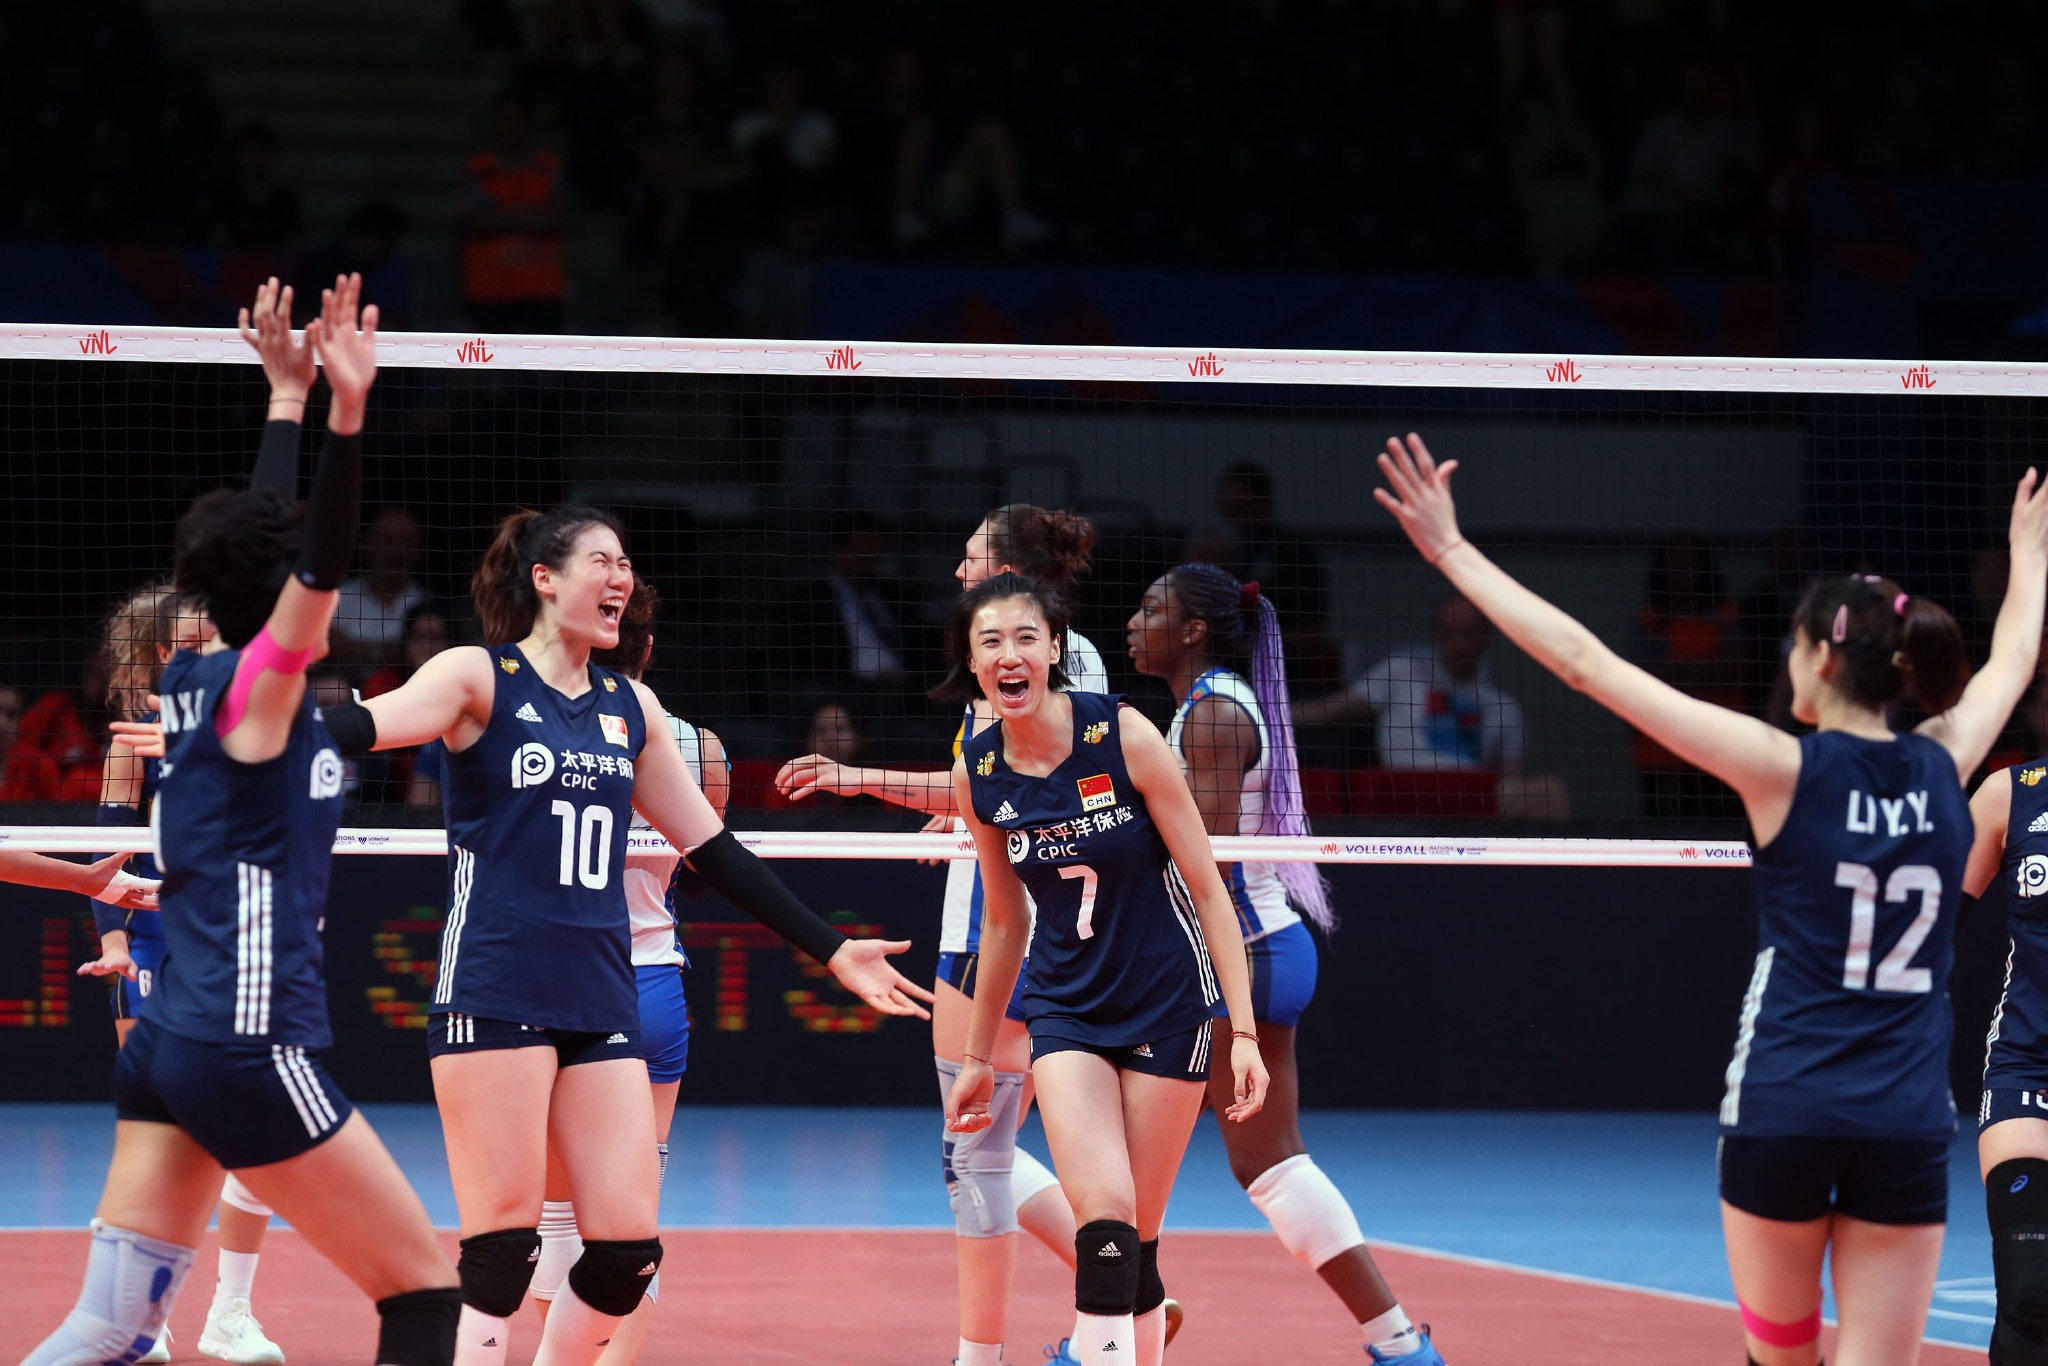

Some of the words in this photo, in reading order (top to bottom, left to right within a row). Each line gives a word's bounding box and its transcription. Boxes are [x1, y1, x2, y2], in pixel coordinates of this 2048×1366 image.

[79, 330, 117, 354] VNL
[456, 339, 494, 364] VNL
[825, 346, 862, 371] VNL
[1187, 353, 1224, 377] VNL
[1546, 359, 1582, 383] VNL
[1901, 366, 1937, 389] VNL
[560, 749, 634, 781] 太平洋保
[561, 773, 597, 790] CPIC
[1087, 794, 1112, 807] CHN
[993, 810, 1019, 823] adidas
[1034, 806, 1134, 845] 太平洋保险
[551, 799, 614, 890] 10
[627, 838, 673, 848] OLLEY
[1037, 843, 1078, 860] CPIC
[1320, 842, 1340, 855] VNL
[1346, 844, 1427, 855] VOLLEYBALL
[1679, 845, 1699, 859] VNL
[1057, 864, 1099, 940] 7
[1834, 861, 1943, 993] 12
[1098, 1250, 1122, 1258] adidas
